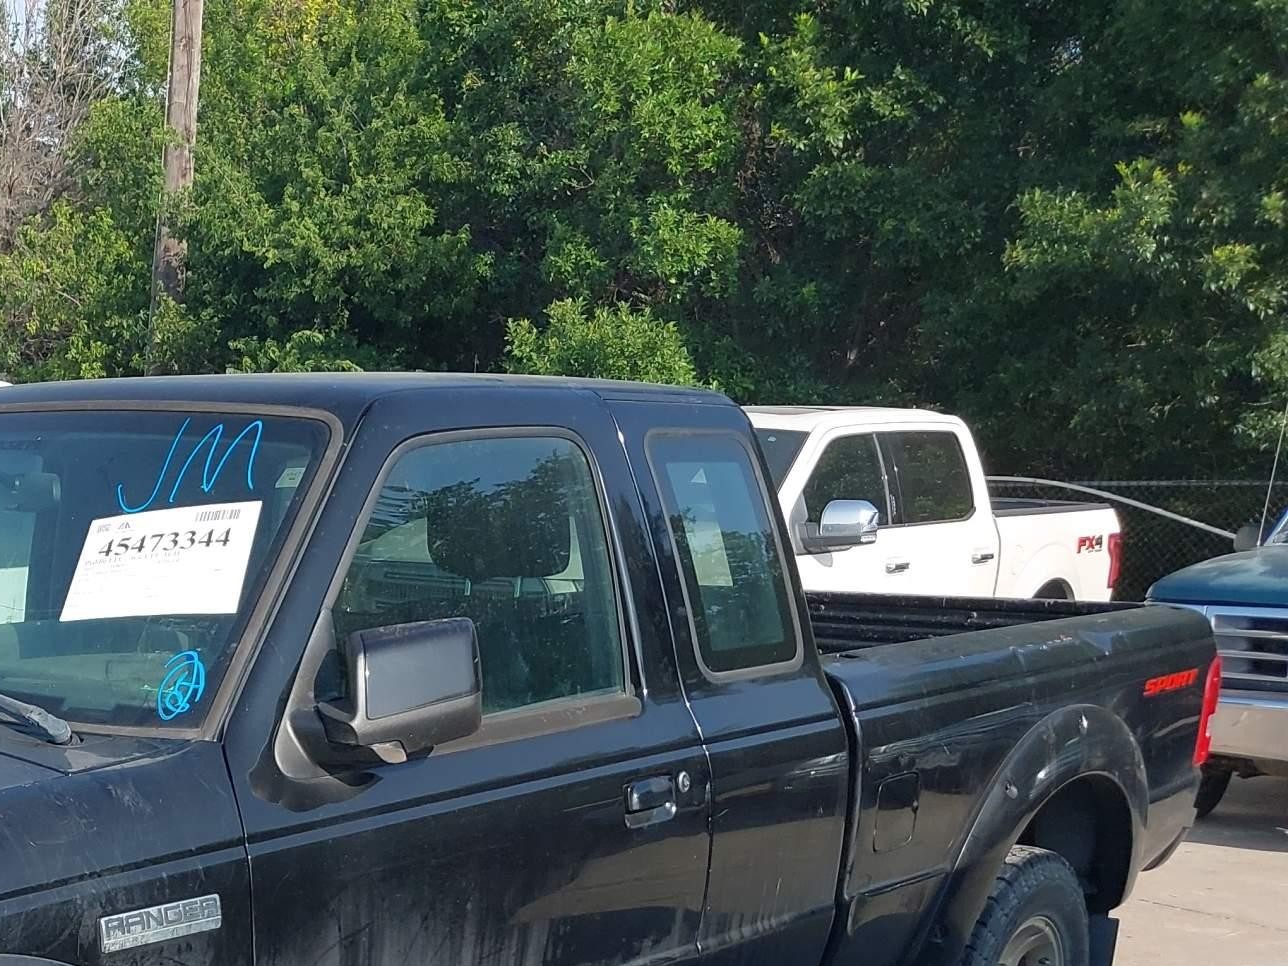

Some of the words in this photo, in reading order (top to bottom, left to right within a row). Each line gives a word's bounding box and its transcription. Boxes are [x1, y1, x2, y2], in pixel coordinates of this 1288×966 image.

[117, 417, 263, 514] JM
[98, 527, 232, 558] 45473344
[1076, 534, 1103, 554] FX4
[1143, 668, 1199, 697] SPORT
[104, 900, 218, 938] RANGER
